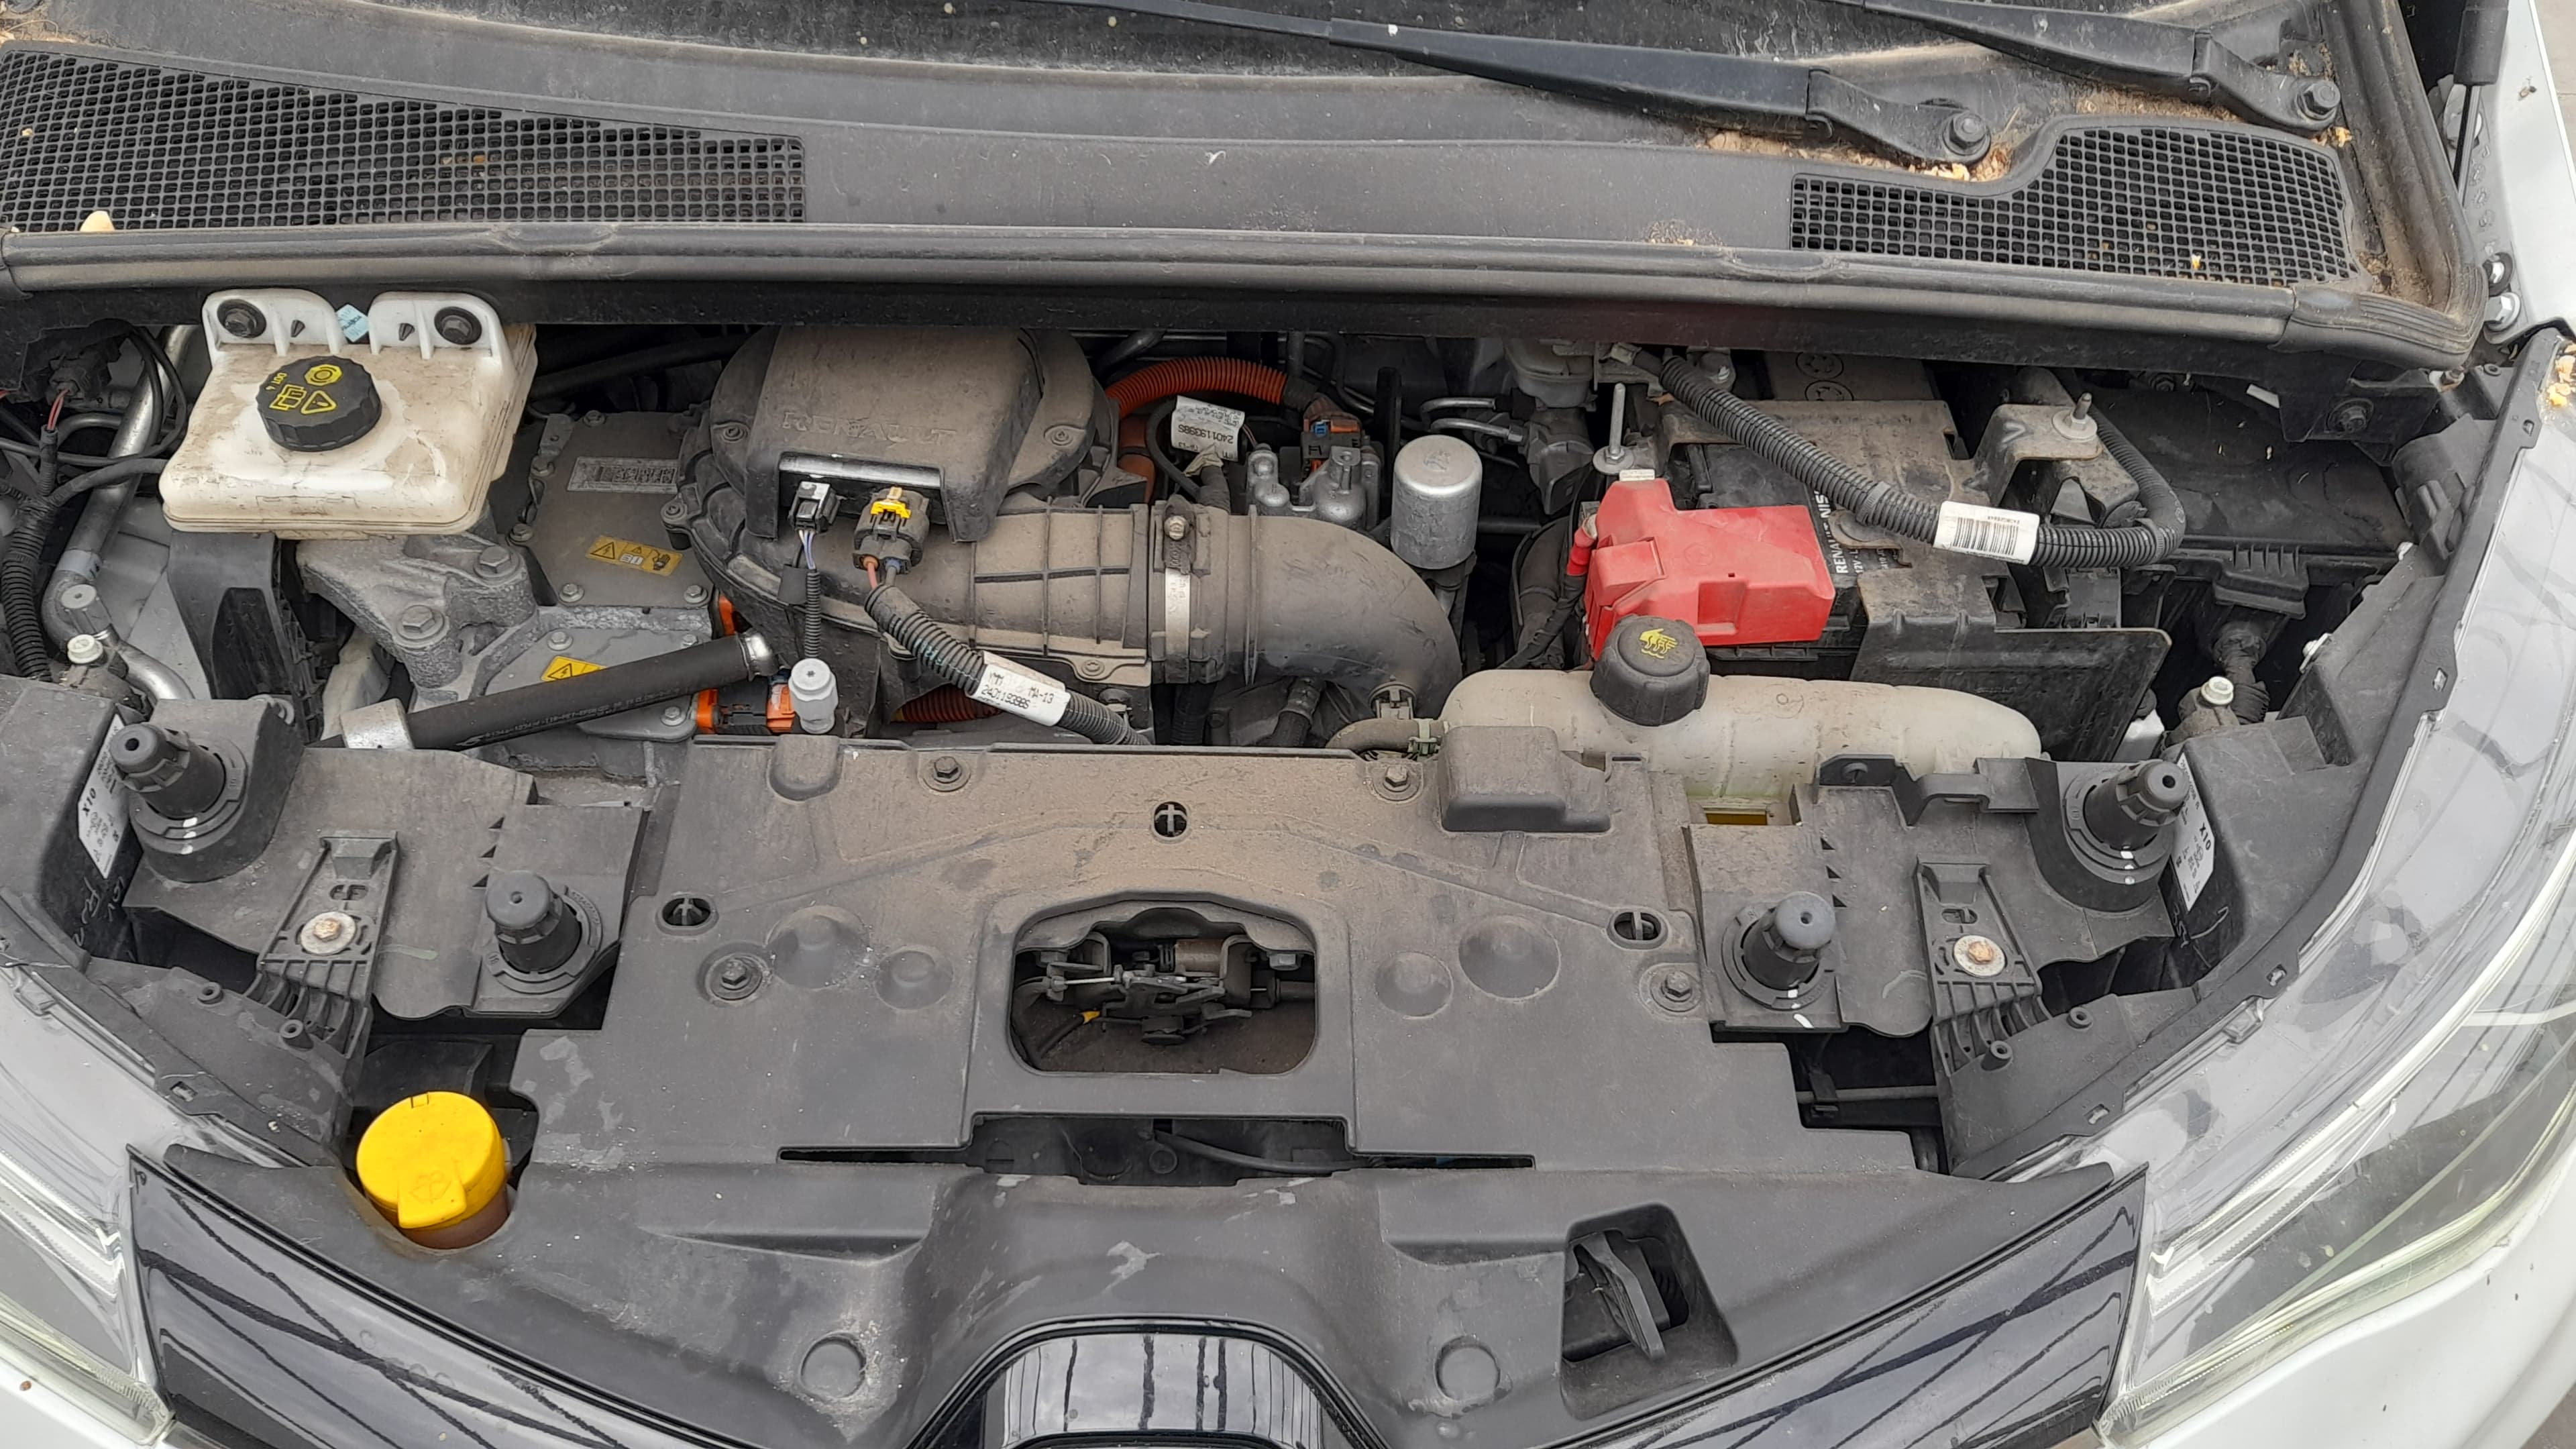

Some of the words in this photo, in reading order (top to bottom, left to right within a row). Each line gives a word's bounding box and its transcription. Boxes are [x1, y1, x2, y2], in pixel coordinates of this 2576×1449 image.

[271, 372, 288, 384] DOT
[1814, 490, 1831, 519] NIS
[81, 787, 97, 817] X10
[2198, 822, 2212, 851] X10
